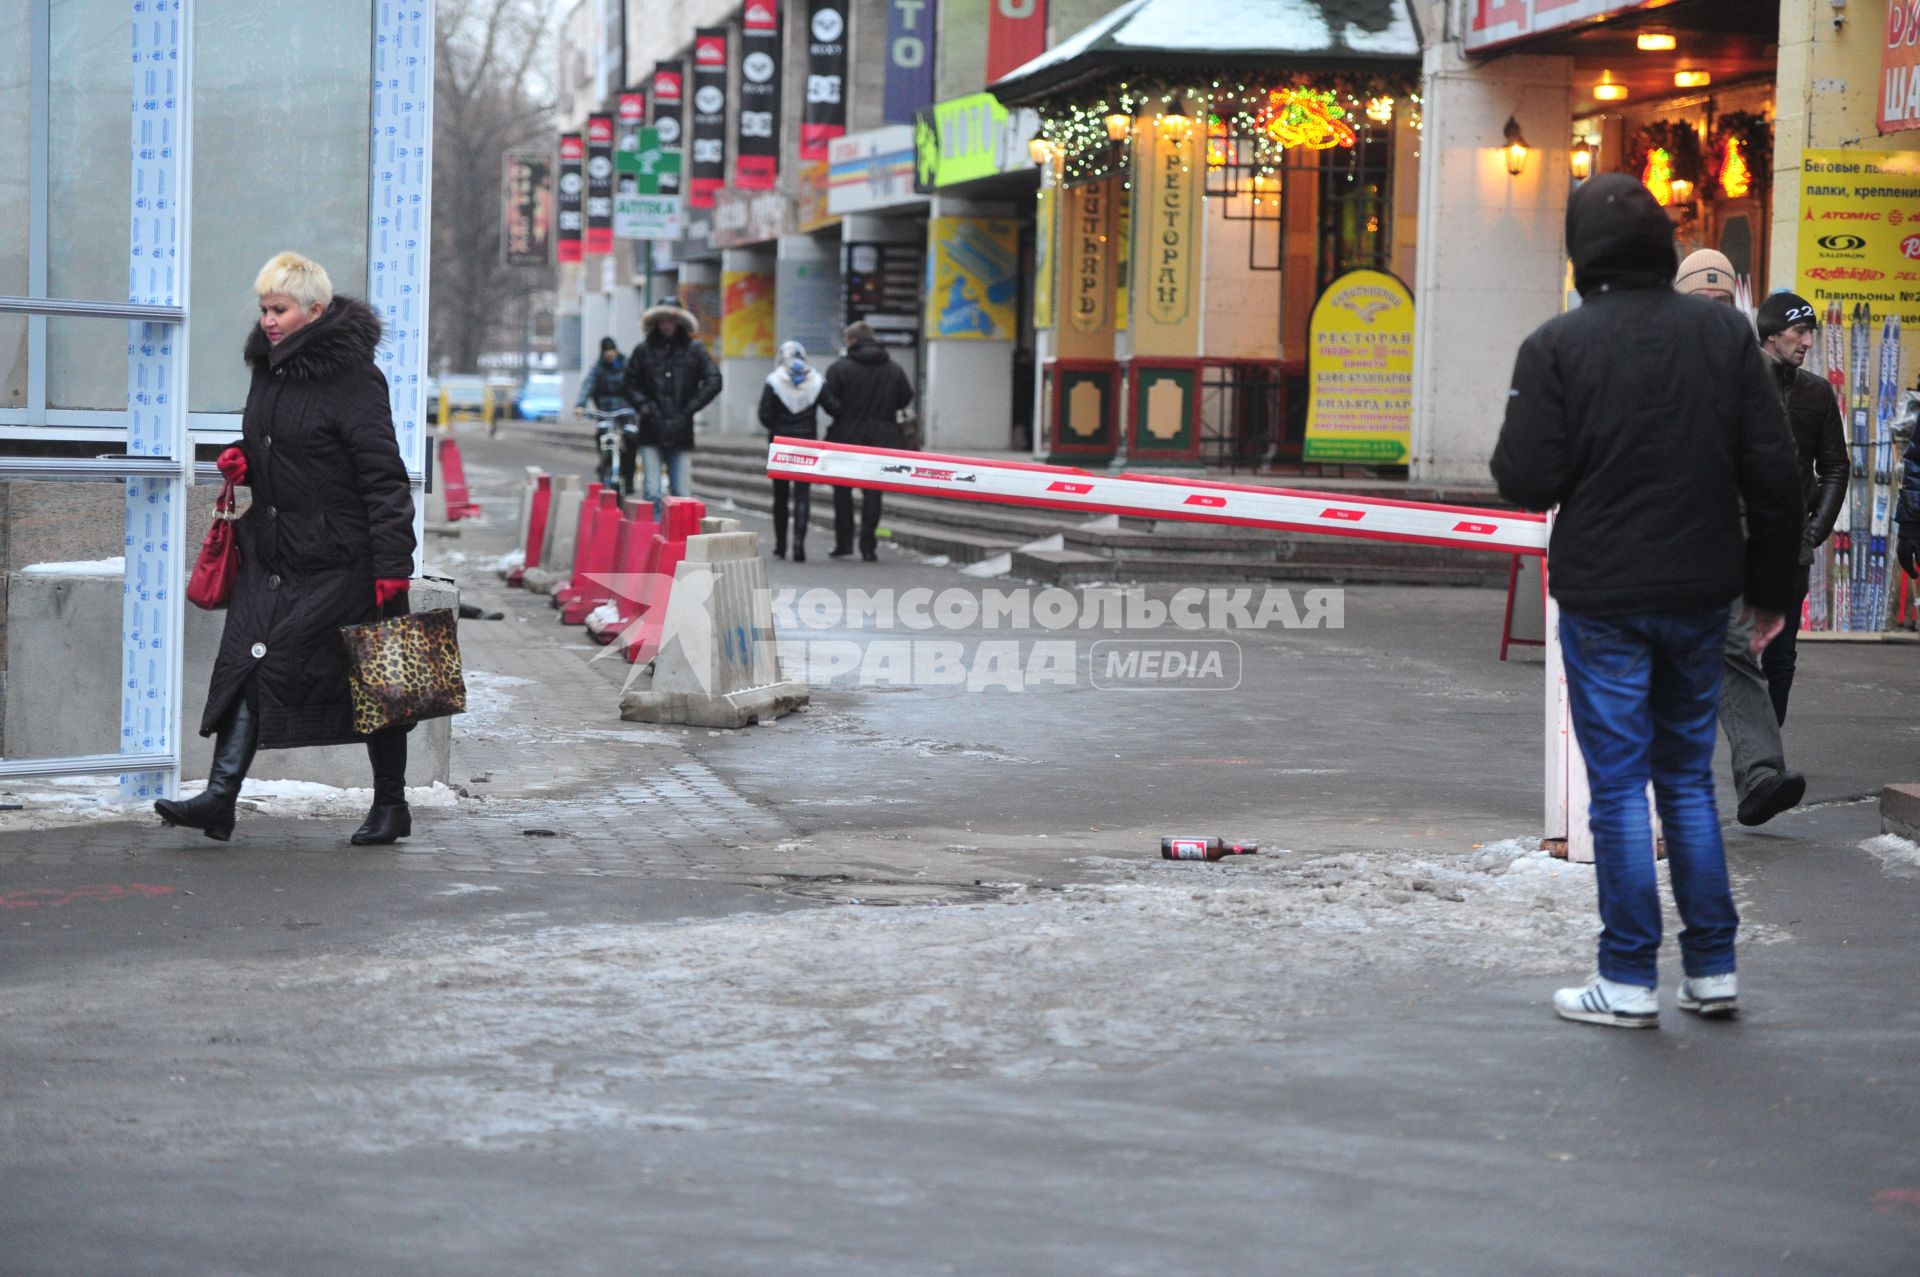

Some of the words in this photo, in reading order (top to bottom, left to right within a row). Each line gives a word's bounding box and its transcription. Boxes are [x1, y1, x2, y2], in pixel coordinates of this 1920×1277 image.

[1804, 158, 1860, 173] Беговые
[1807, 185, 1850, 199] палки,
[1821, 211, 1882, 221] ATOMIC
[1158, 155, 1181, 303] РЕСТОРАН
[1815, 289, 1896, 301] Павильоны
[1318, 332, 1411, 344] РЕСТОРАН
